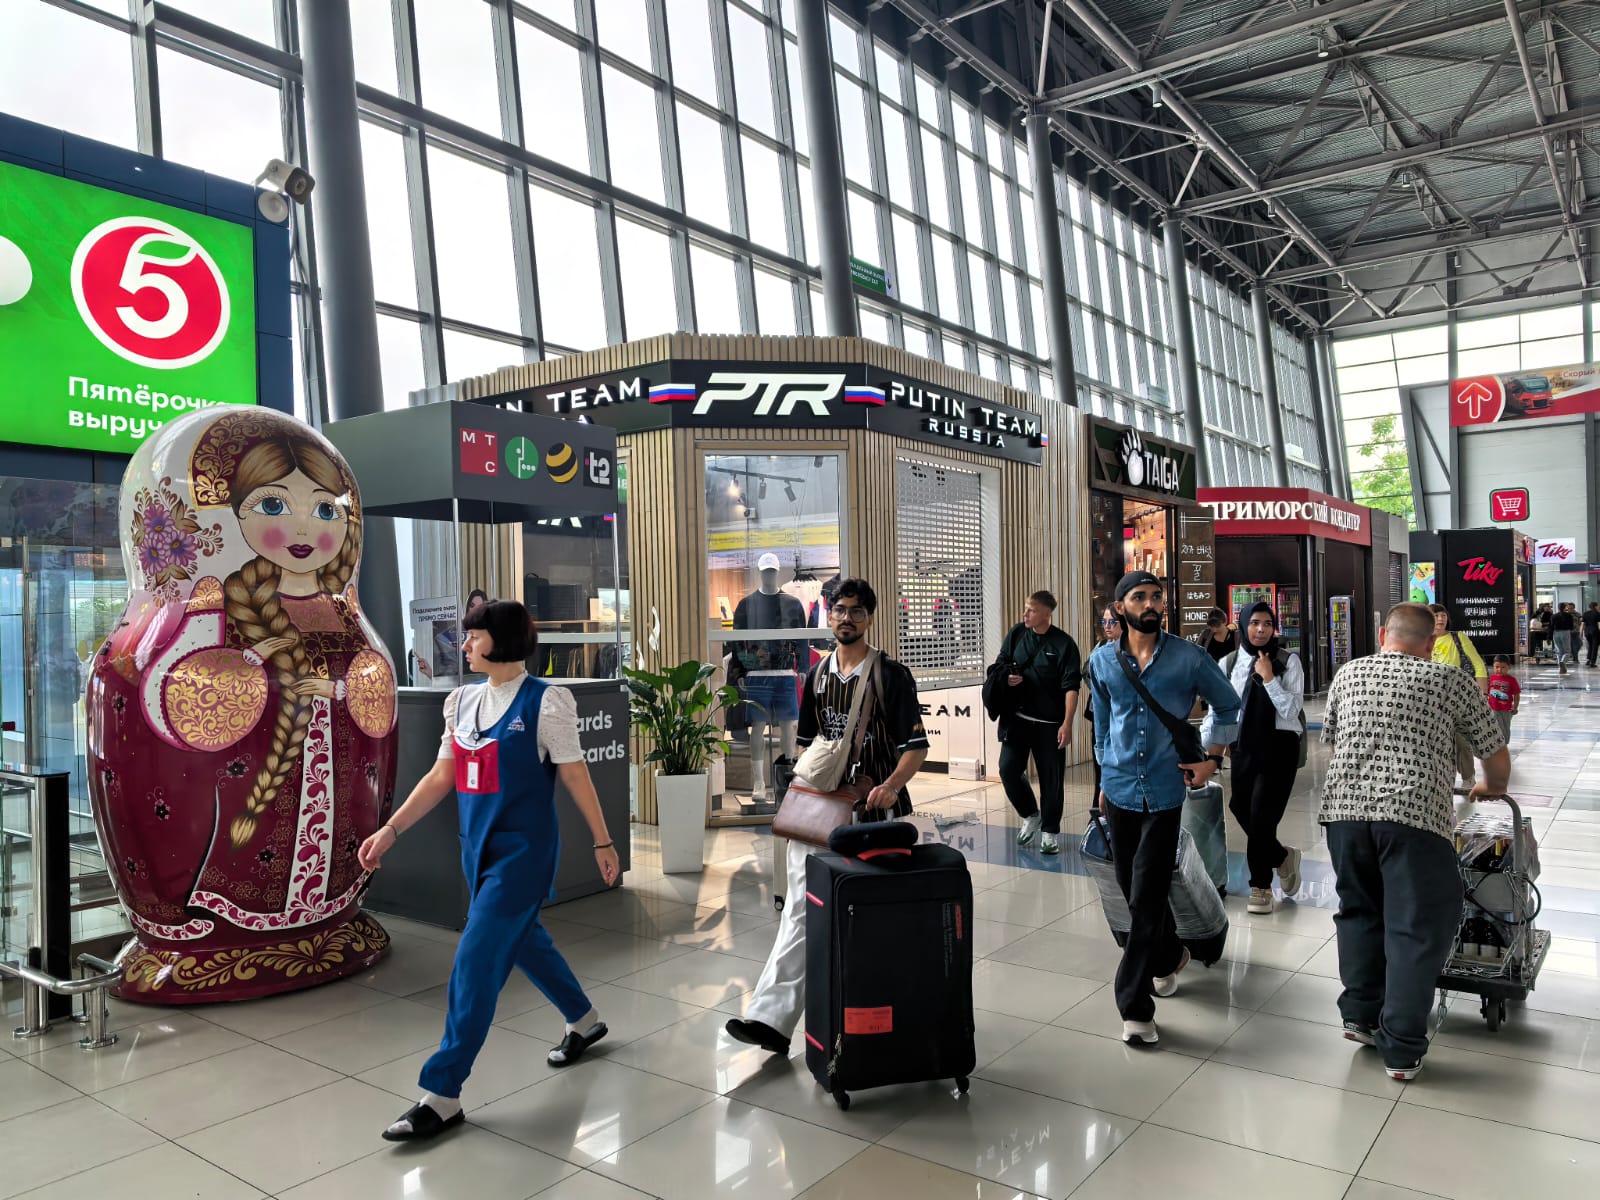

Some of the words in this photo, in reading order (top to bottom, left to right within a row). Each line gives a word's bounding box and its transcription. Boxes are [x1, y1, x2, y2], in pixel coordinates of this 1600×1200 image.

[115, 232, 195, 340] 5
[69, 376, 229, 412] Пятёрочк
[546, 377, 641, 412] TEAM
[692, 373, 846, 415] PTR
[891, 381, 965, 419] PUTIN
[981, 407, 1036, 437] TEAM
[68, 410, 163, 438] выруч
[929, 418, 1005, 448] RUSSIA
[1144, 451, 1180, 492] TAIGA
[576, 710, 613, 732] ards
[919, 704, 971, 717] EAM
